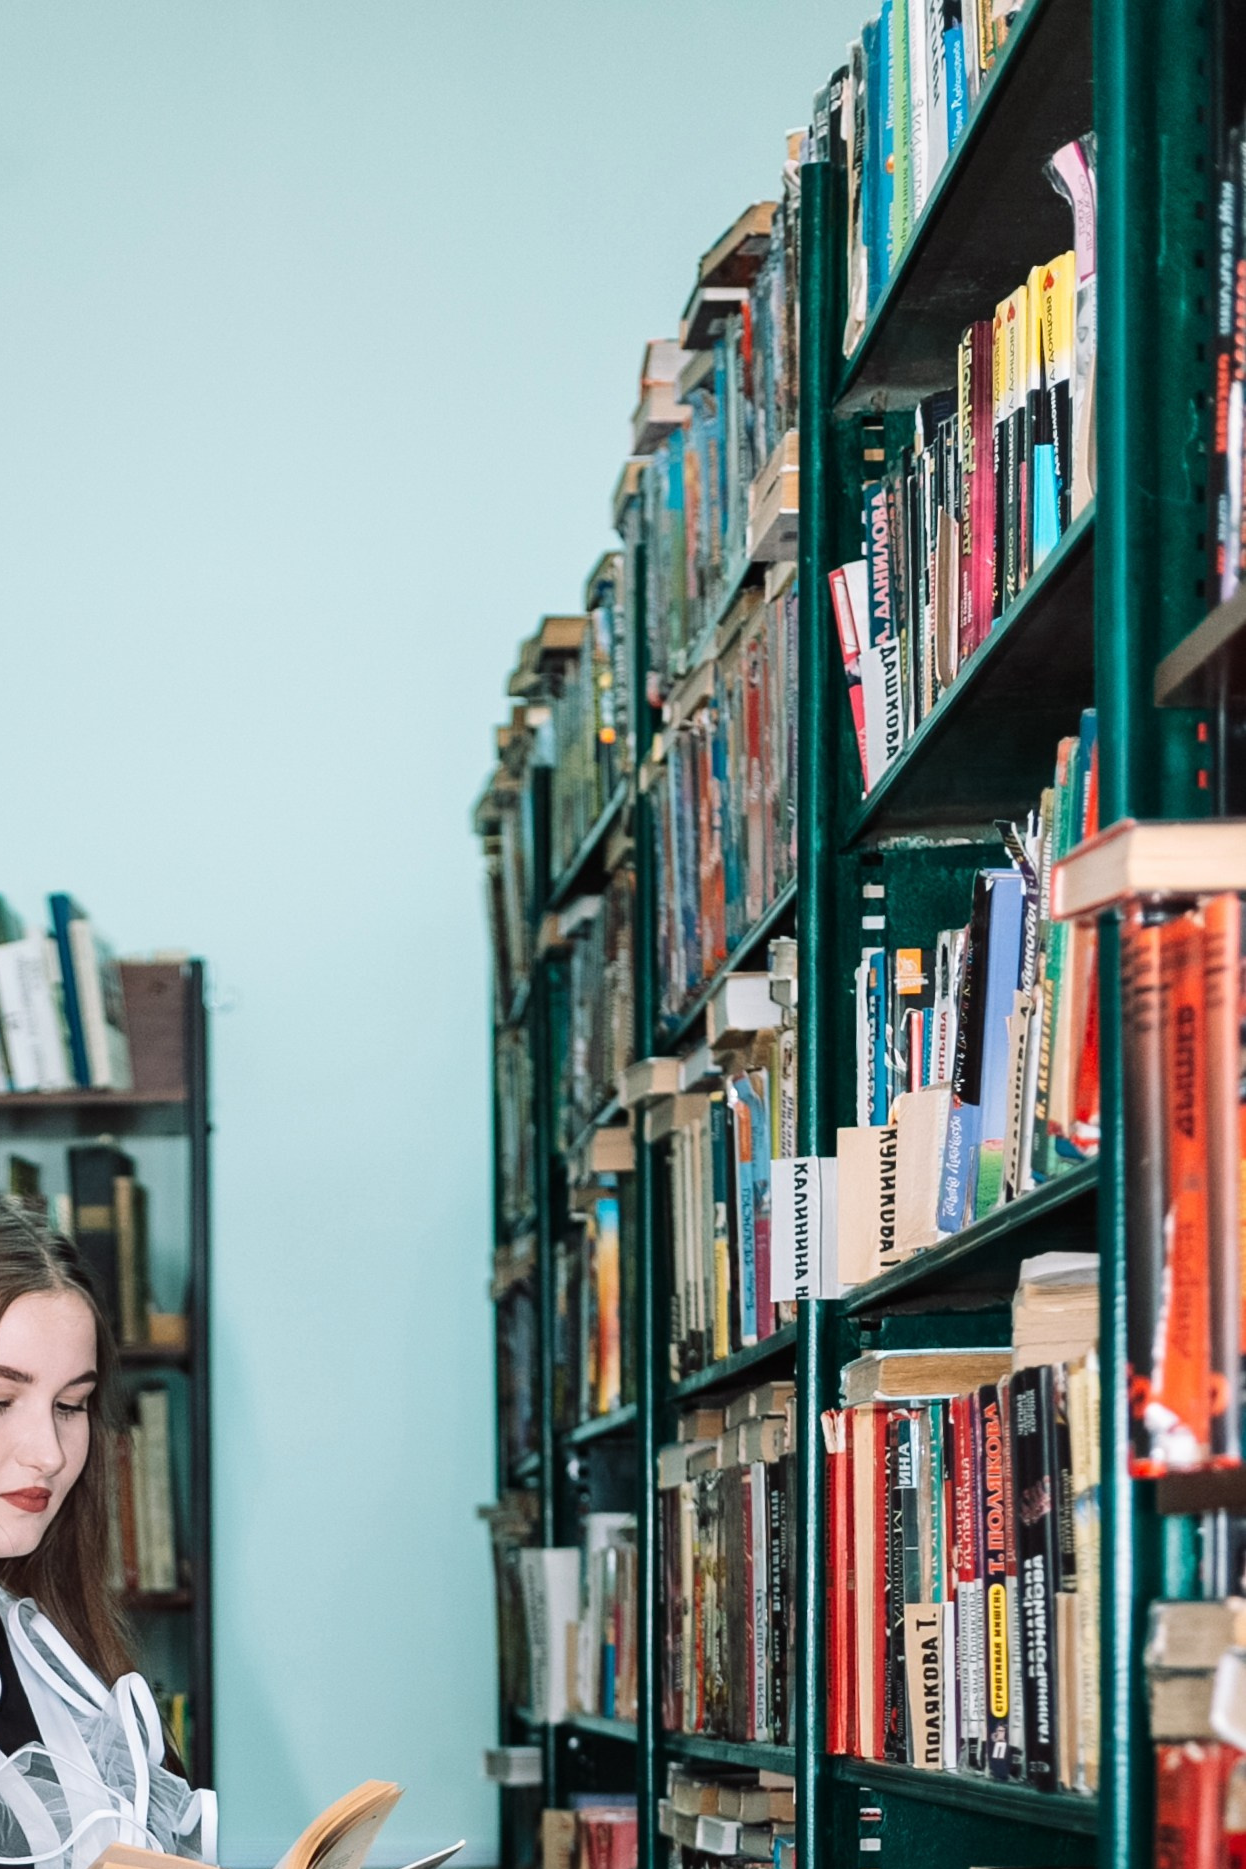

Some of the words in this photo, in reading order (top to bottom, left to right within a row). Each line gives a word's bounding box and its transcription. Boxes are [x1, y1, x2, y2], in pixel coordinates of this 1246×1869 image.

[1045, 295, 1056, 362] Донцова
[960, 327, 976, 475] Донцова
[869, 492, 891, 620] ДАНИЛОВА
[961, 481, 973, 556] Дарья
[880, 645, 900, 761] ДАШКОВА
[793, 1162, 810, 1281] КАЛИНИНА
[879, 1128, 898, 1253] КУЛИКОВА
[983, 1401, 1004, 1551] ПОЛЯКОВА
[988, 1552, 1004, 1576] Т.
[915, 1612, 937, 1632] Т.
[960, 1591, 968, 1662] Полякова
[992, 1589, 1002, 1638] МИШЕНЬ
[920, 1636, 941, 1764] ПОЛЯКОВА
[993, 1642, 1003, 1713] СТРОПТИВАЯ
[1036, 1677, 1050, 1744] ГАЛИНА
